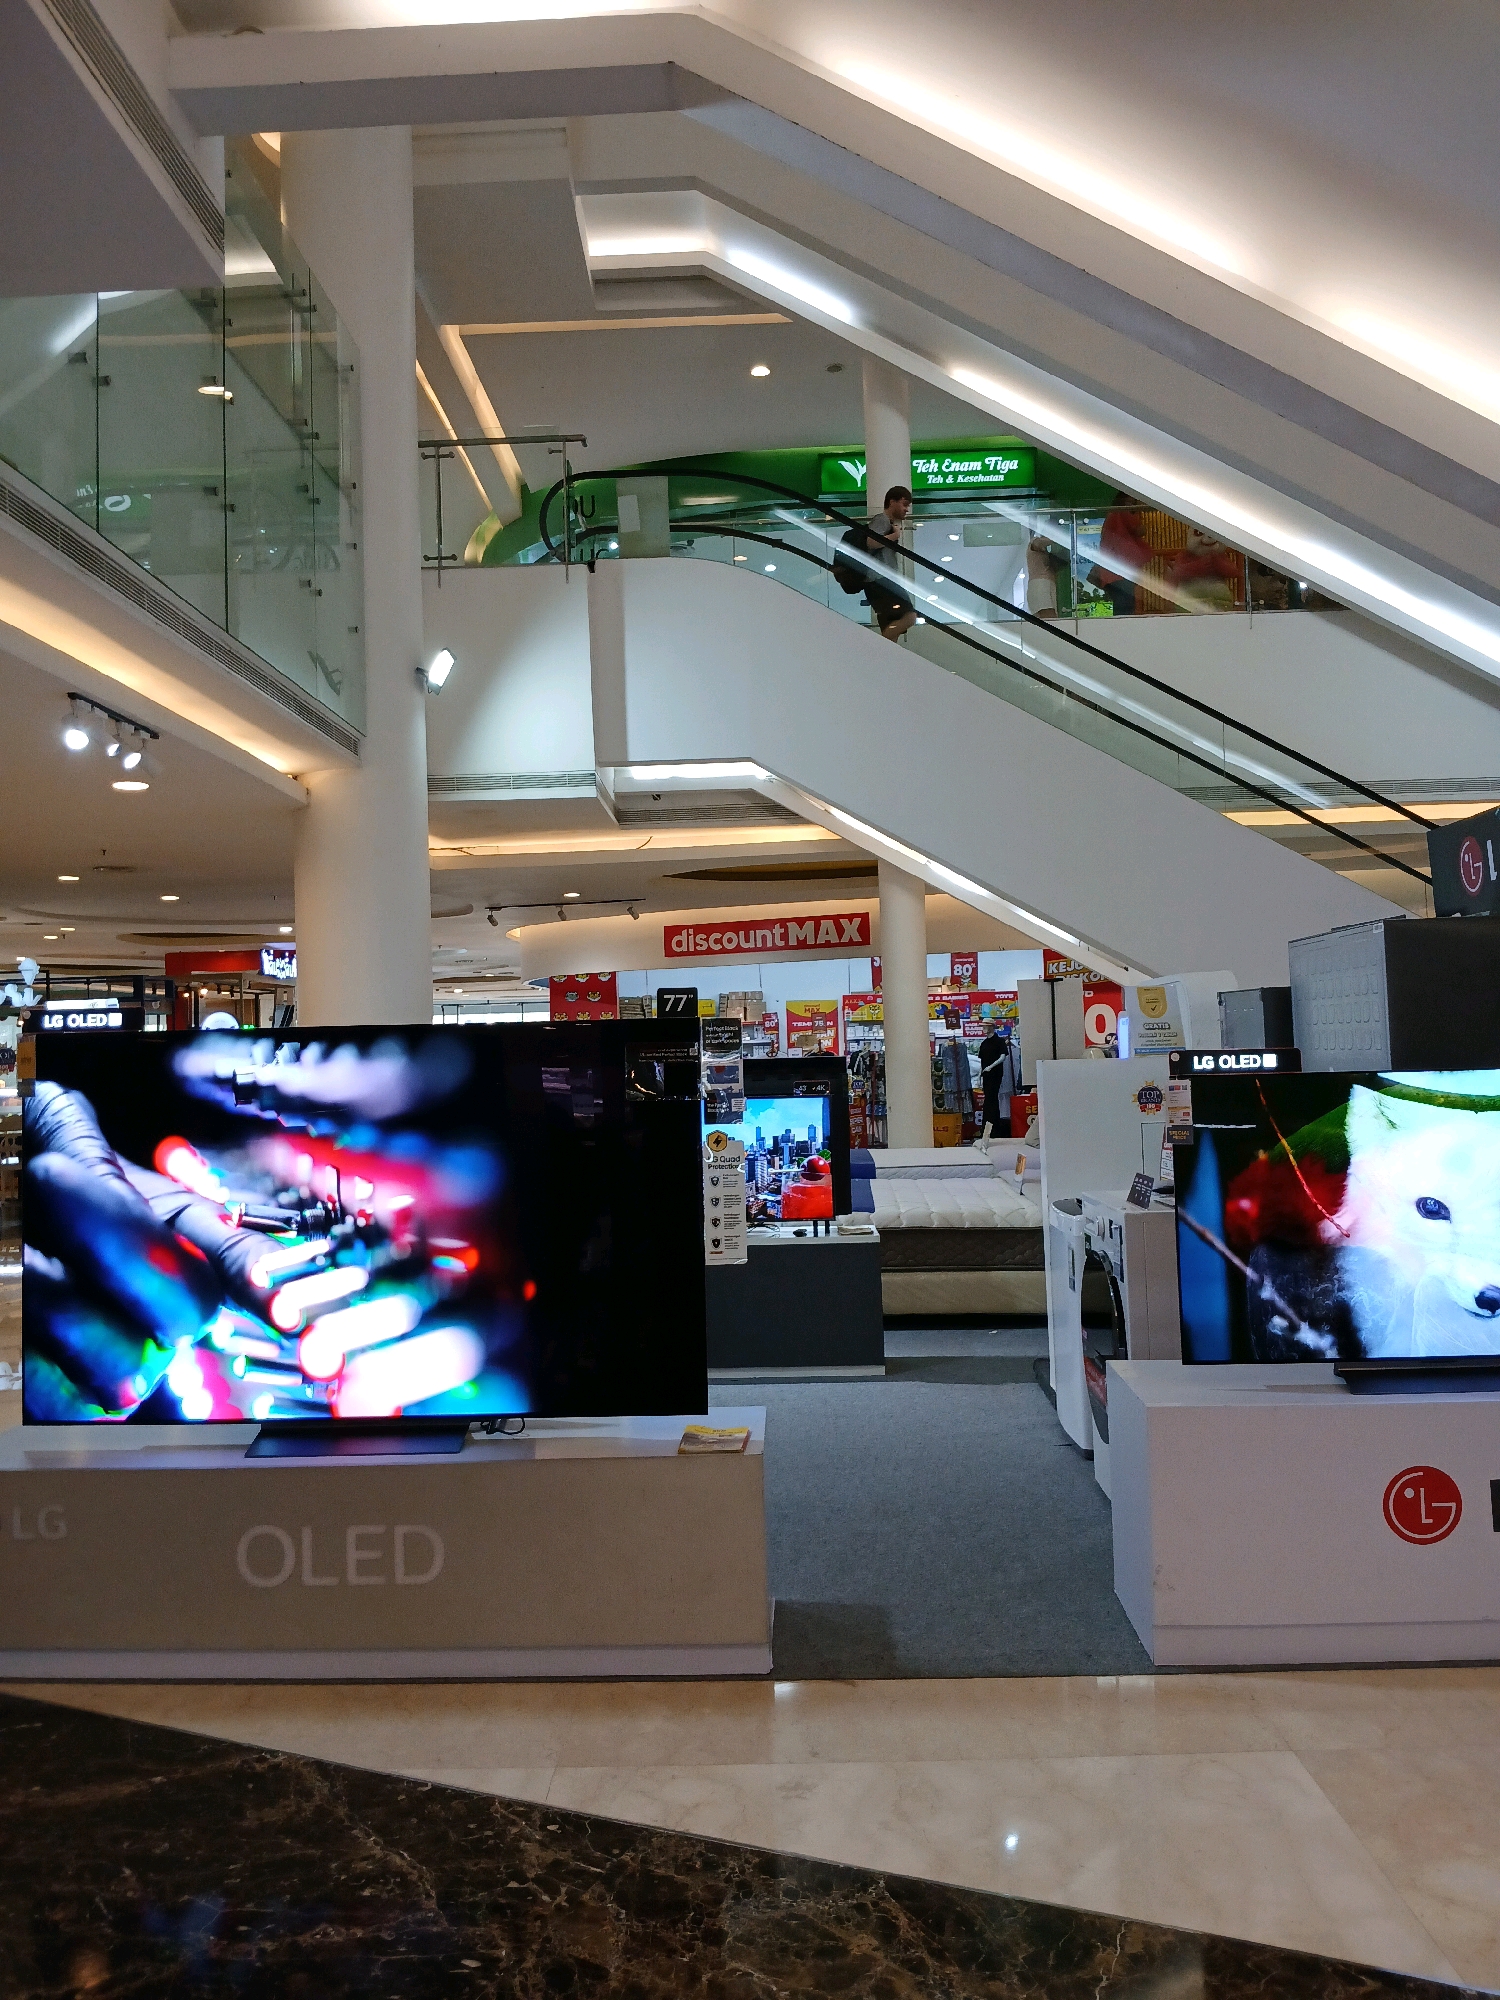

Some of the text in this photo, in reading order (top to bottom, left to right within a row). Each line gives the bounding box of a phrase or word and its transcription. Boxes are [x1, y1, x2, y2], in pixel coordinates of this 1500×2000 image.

[912, 456, 1019, 474] Teh Enam Tiga
[927, 474, 1005, 484] Teh & Kesehatan
[671, 917, 863, 953] discountMAX
[44, 1013, 108, 1028] LG OLED
[1193, 1054, 1262, 1069] LG OLED
[719, 1155, 741, 1163] Quad
[11, 1505, 69, 1541] LG
[235, 1524, 447, 1588] OLED
